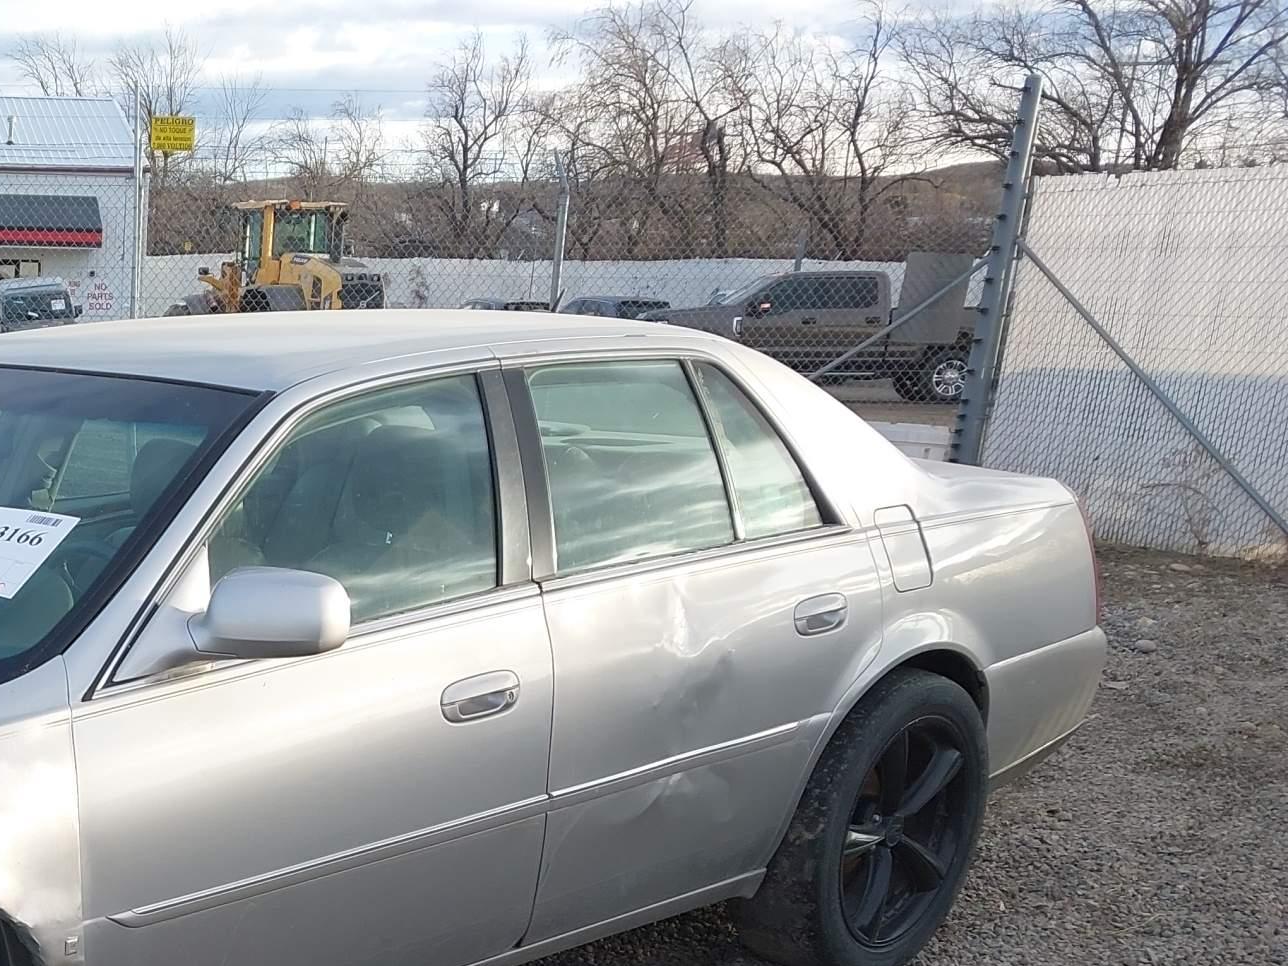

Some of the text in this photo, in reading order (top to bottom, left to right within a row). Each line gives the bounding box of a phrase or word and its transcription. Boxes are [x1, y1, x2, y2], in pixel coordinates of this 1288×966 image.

[94, 283, 108, 291] NO
[87, 293, 114, 301] PARTS
[88, 302, 112, 310] SOLD
